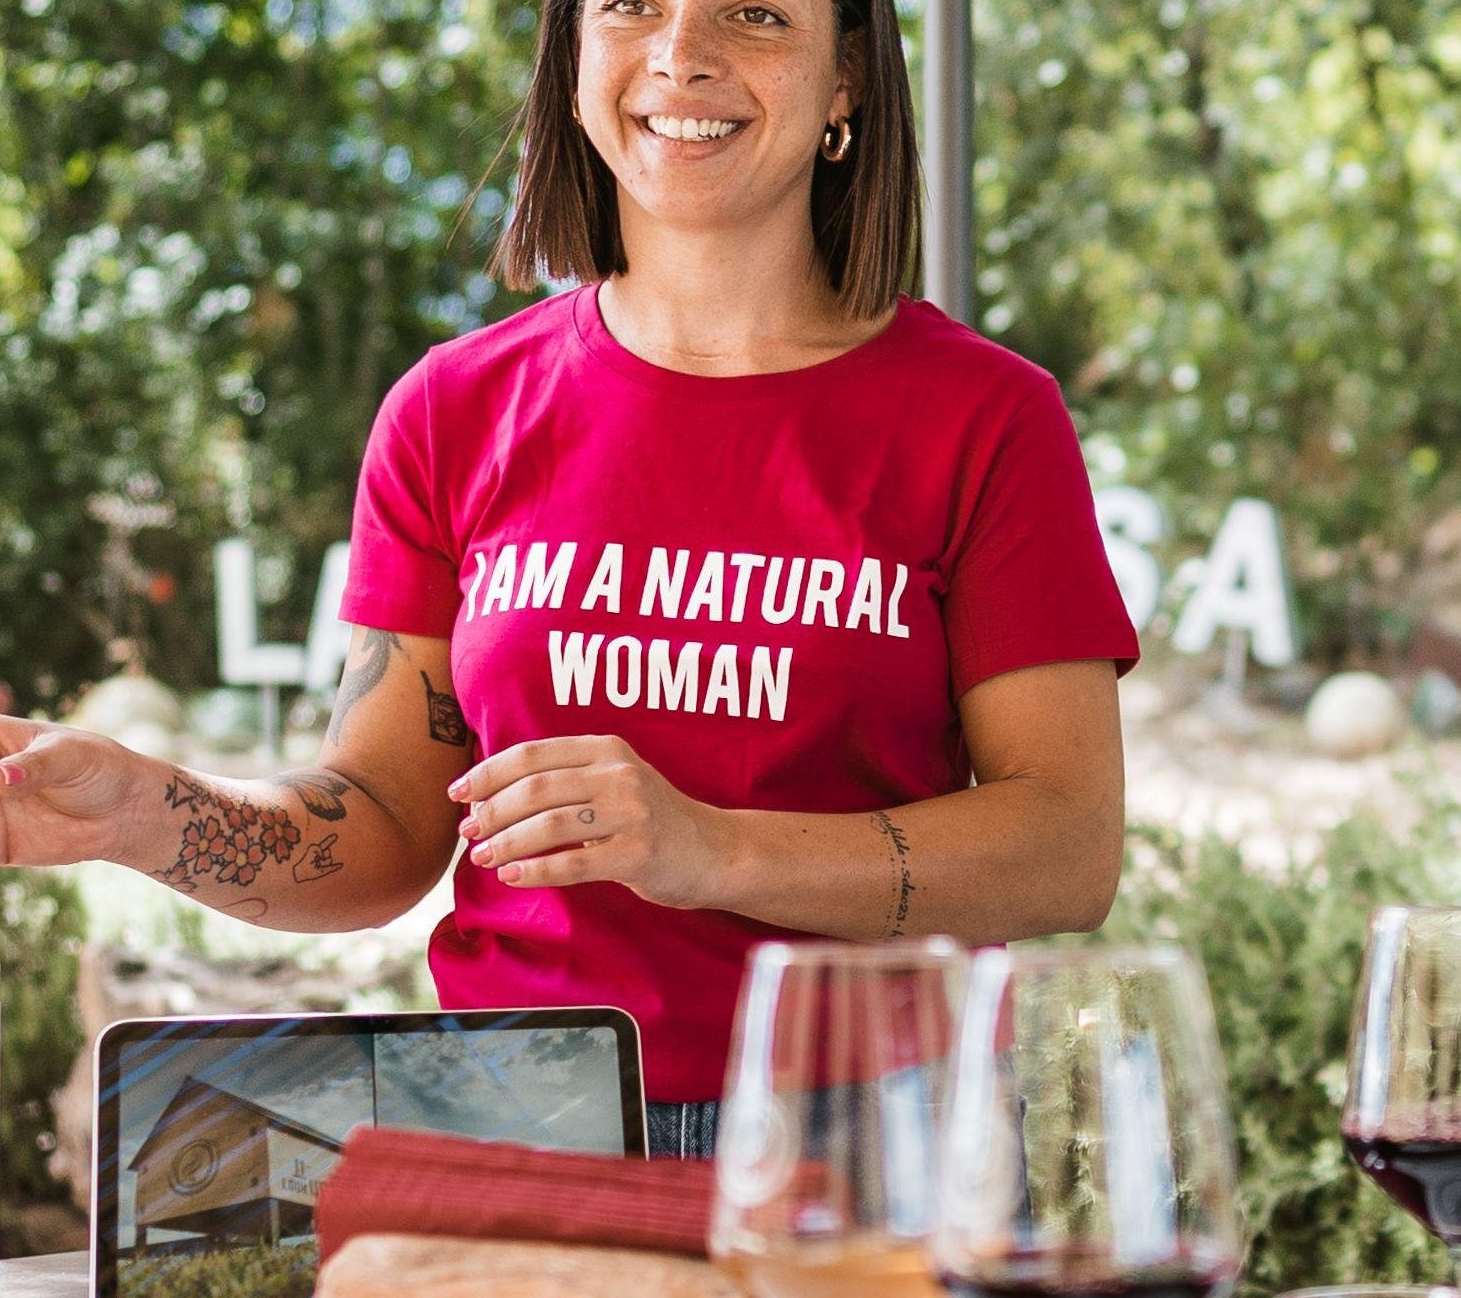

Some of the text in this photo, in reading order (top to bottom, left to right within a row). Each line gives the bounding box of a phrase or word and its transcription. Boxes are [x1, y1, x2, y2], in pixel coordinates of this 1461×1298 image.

[465, 541, 910, 639] I AM A NATURAL
[548, 630, 794, 722] WOMAN
